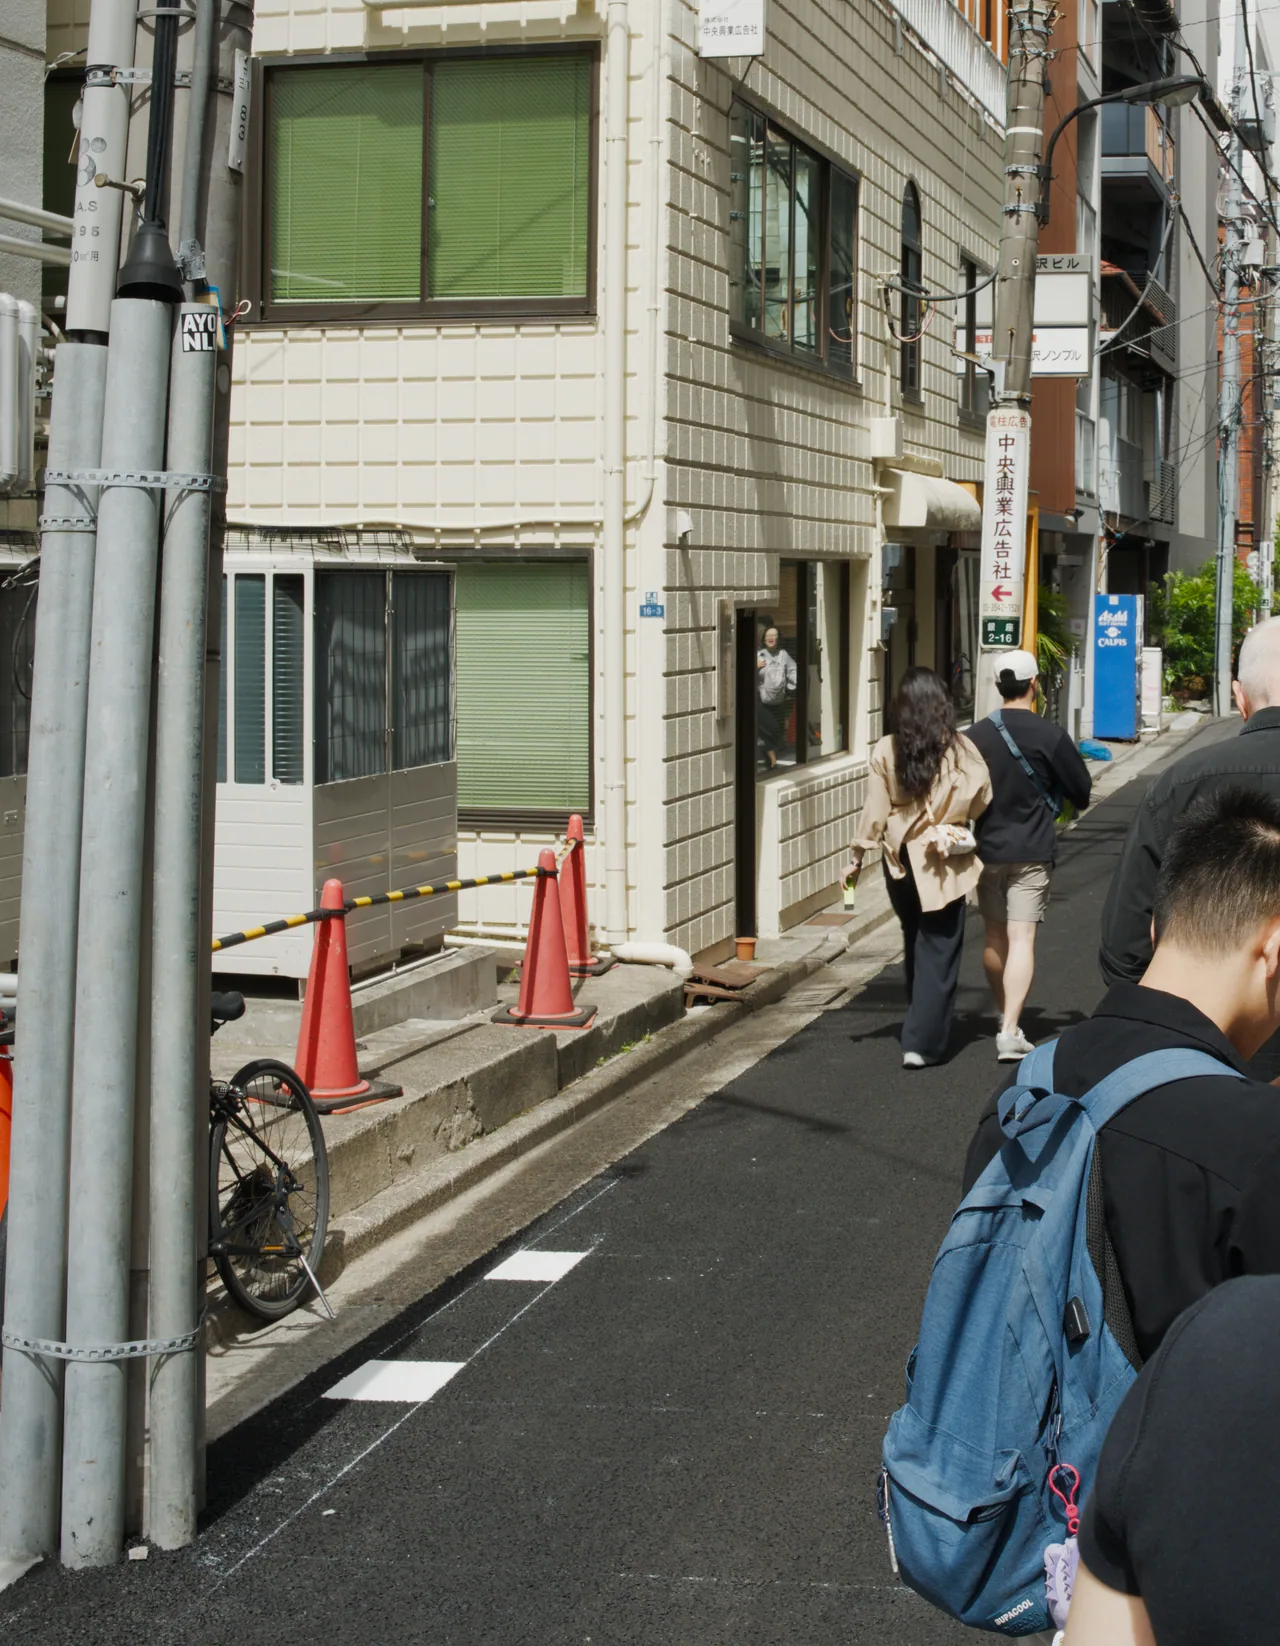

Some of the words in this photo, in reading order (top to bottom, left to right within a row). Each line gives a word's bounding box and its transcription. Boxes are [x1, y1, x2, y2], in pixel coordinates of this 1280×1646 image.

[992, 433, 1016, 580] 中央興業広告社
[1098, 610, 1128, 623] Asahi
[988, 633, 1013, 643] 2-16
[1097, 638, 1128, 647] CALPIS
